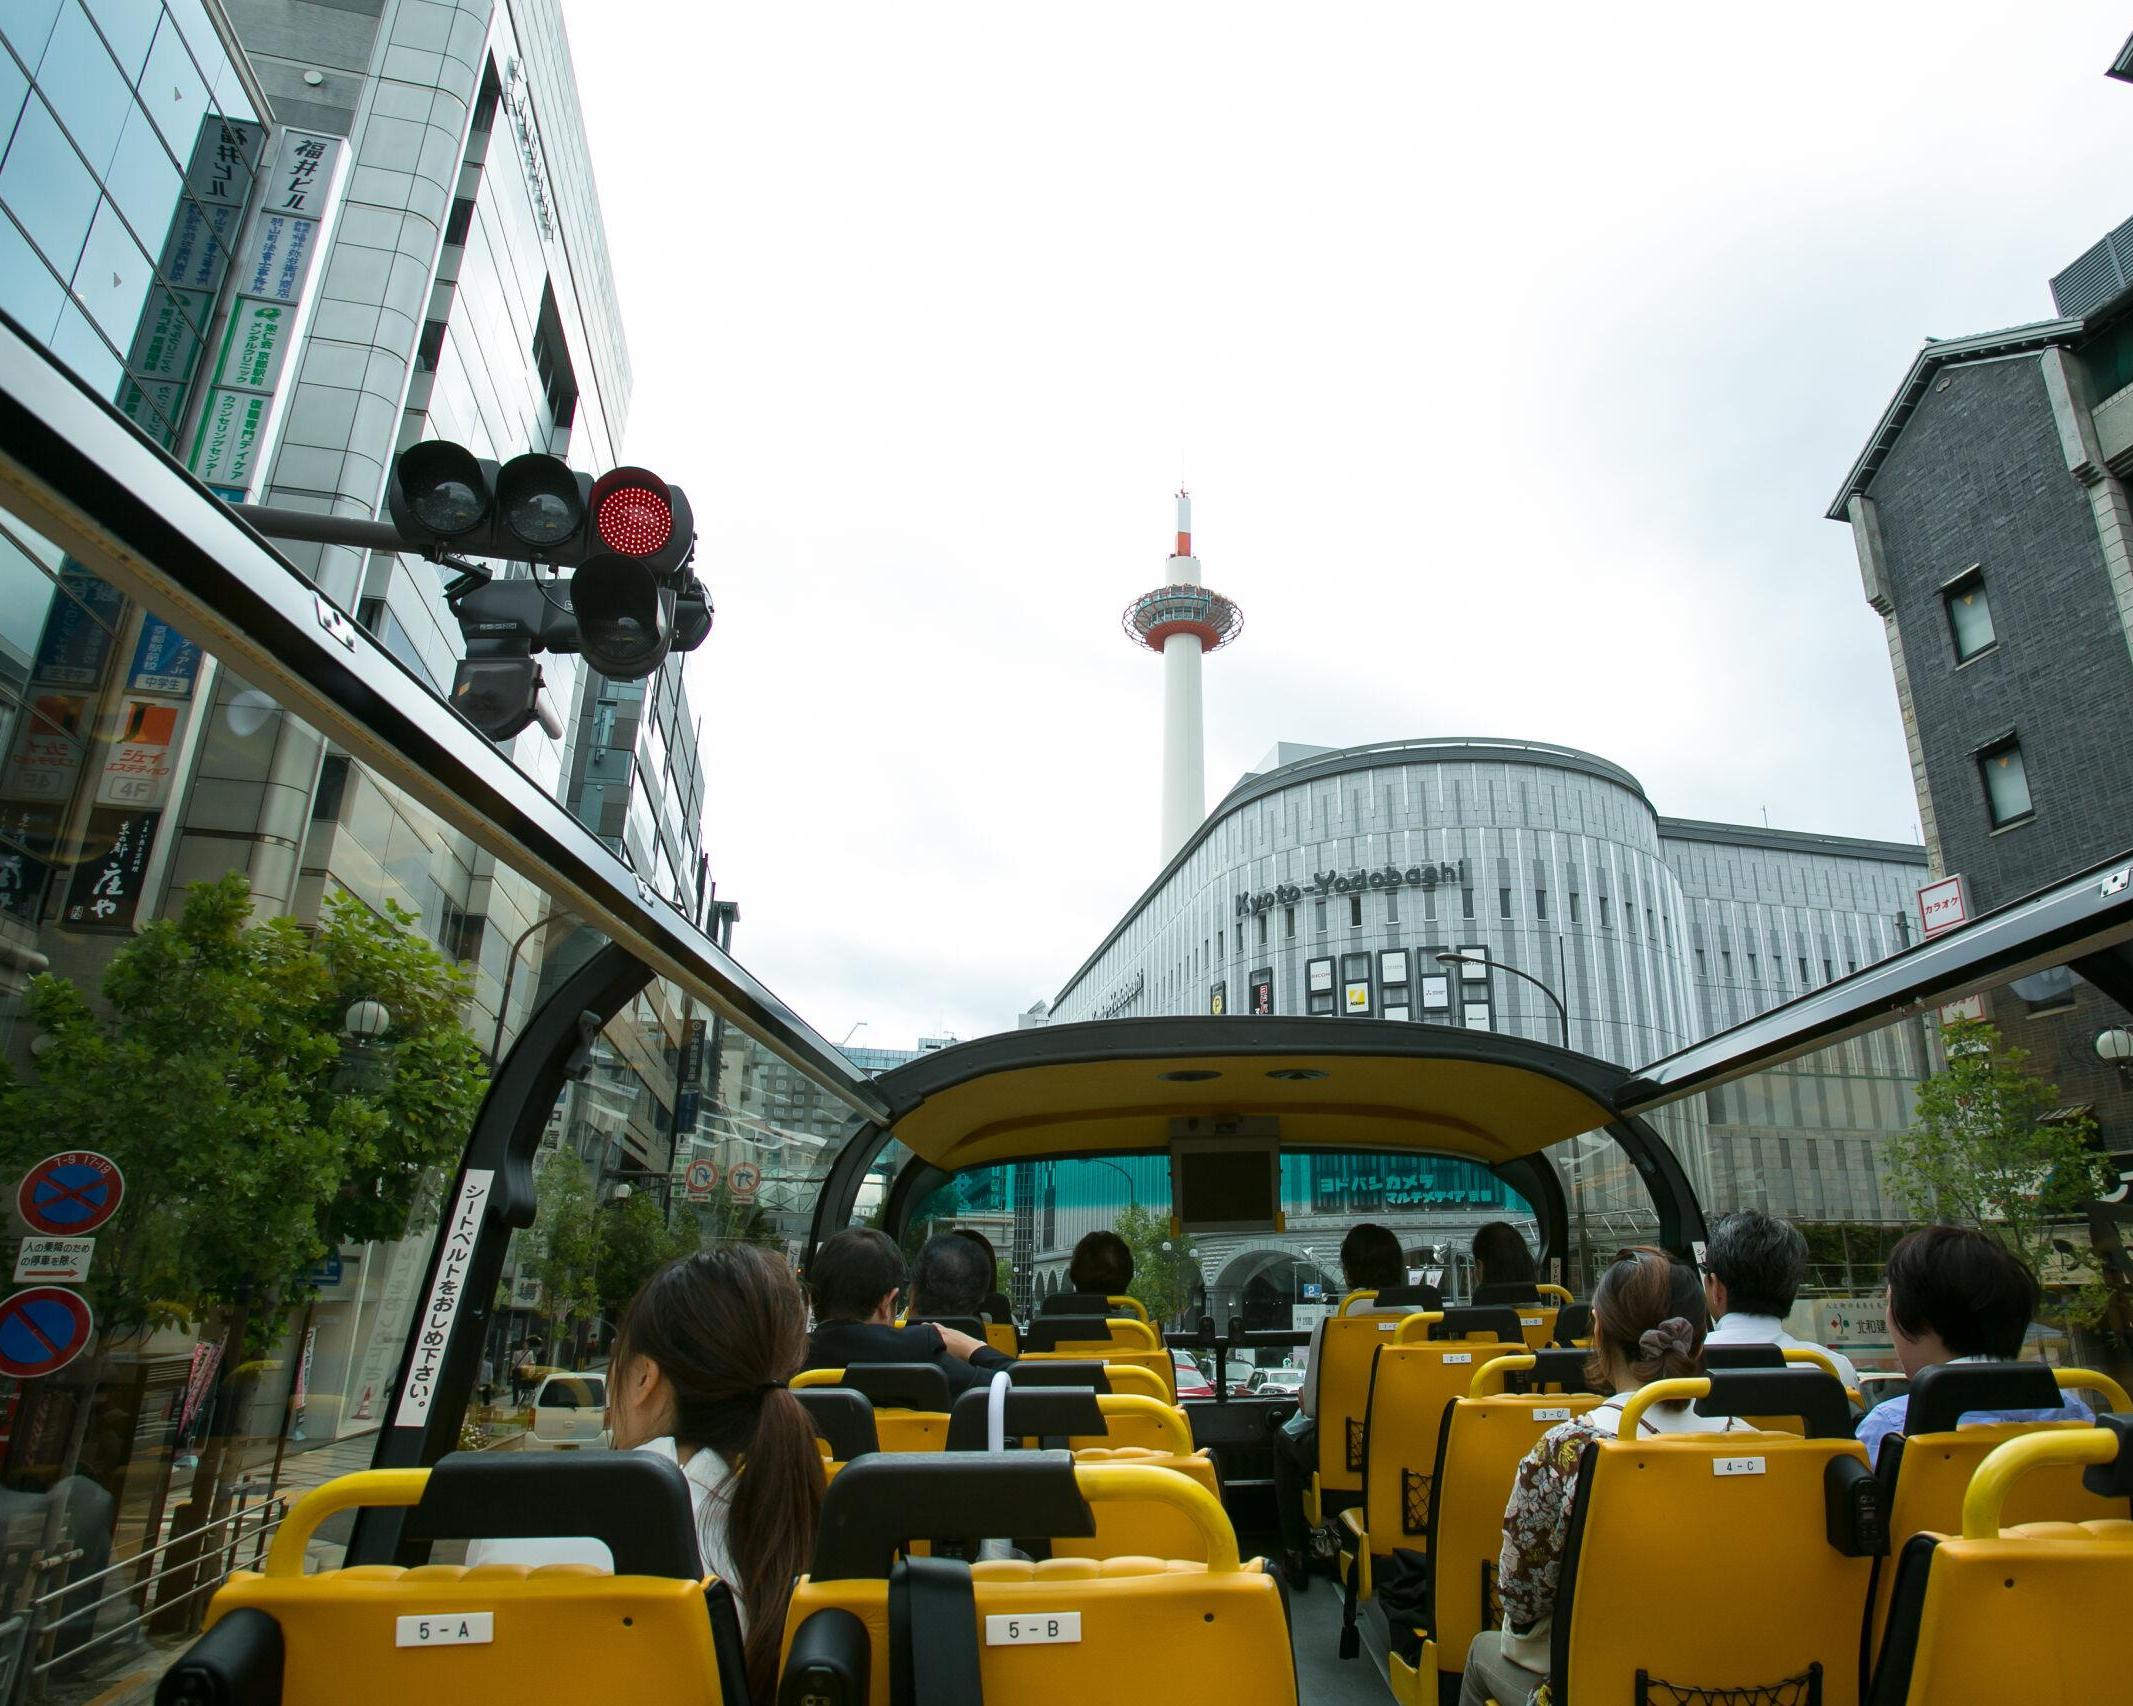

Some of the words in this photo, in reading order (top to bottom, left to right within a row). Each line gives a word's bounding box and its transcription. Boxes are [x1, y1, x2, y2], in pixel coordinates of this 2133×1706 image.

[281, 139, 328, 211] 福井ビル
[236, 321, 263, 384] メンタルクリニック
[250, 351, 271, 387] 京都駅前
[204, 394, 237, 479] カウンセリングセンター
[145, 676, 181, 691] 中学生
[120, 749, 168, 764] ジェイ
[104, 762, 170, 776] エステティック
[120, 781, 149, 798] 4F
[91, 861, 124, 919] 庄や
[1235, 860, 1464, 917] Kyoto-Yodobashi
[1925, 896, 1960, 915] カラオケ
[56, 1154, 76, 1168] 7-9
[1320, 1174, 1436, 1193] ヨドバシカメラ
[20, 1254, 79, 1267] の停車を除く
[409, 1184, 485, 1408] シートベルトをおしめ下さい。
[1726, 1460, 1755, 1472] 4-C
[419, 1620, 470, 1641] 5-A
[1008, 1620, 1059, 1640] 5-B
